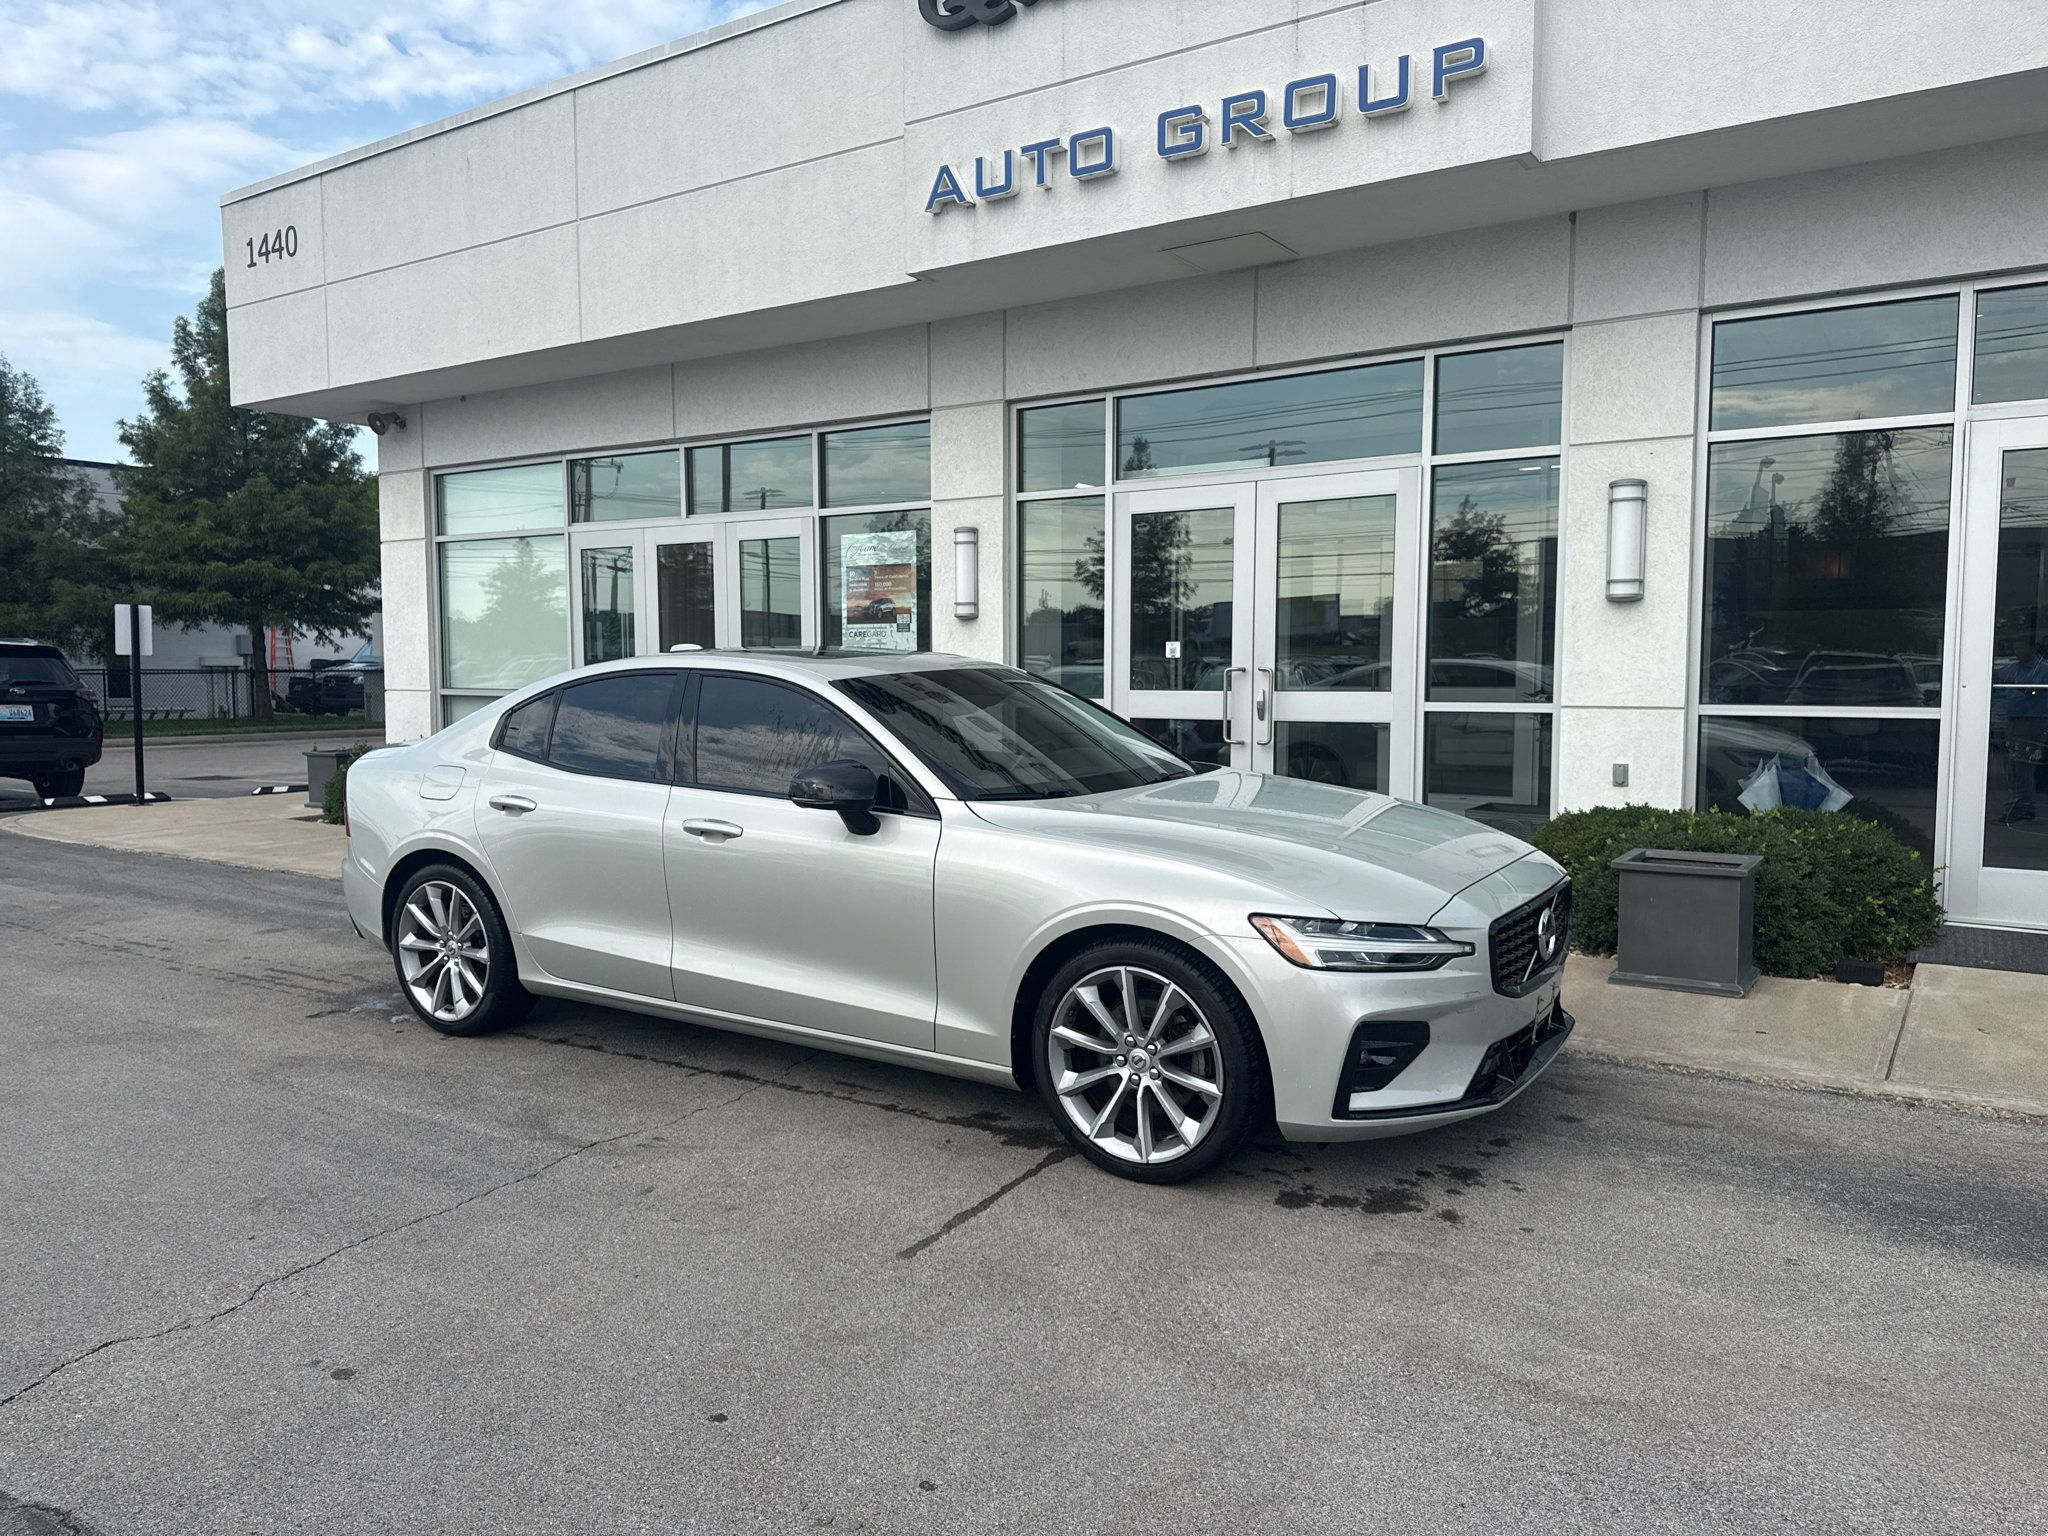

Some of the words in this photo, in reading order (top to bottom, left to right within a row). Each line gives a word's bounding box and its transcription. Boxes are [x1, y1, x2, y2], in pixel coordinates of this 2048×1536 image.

[925, 126, 1118, 213] AUTO
[1157, 36, 1488, 160] GROUP
[246, 225, 298, 268] 1440
